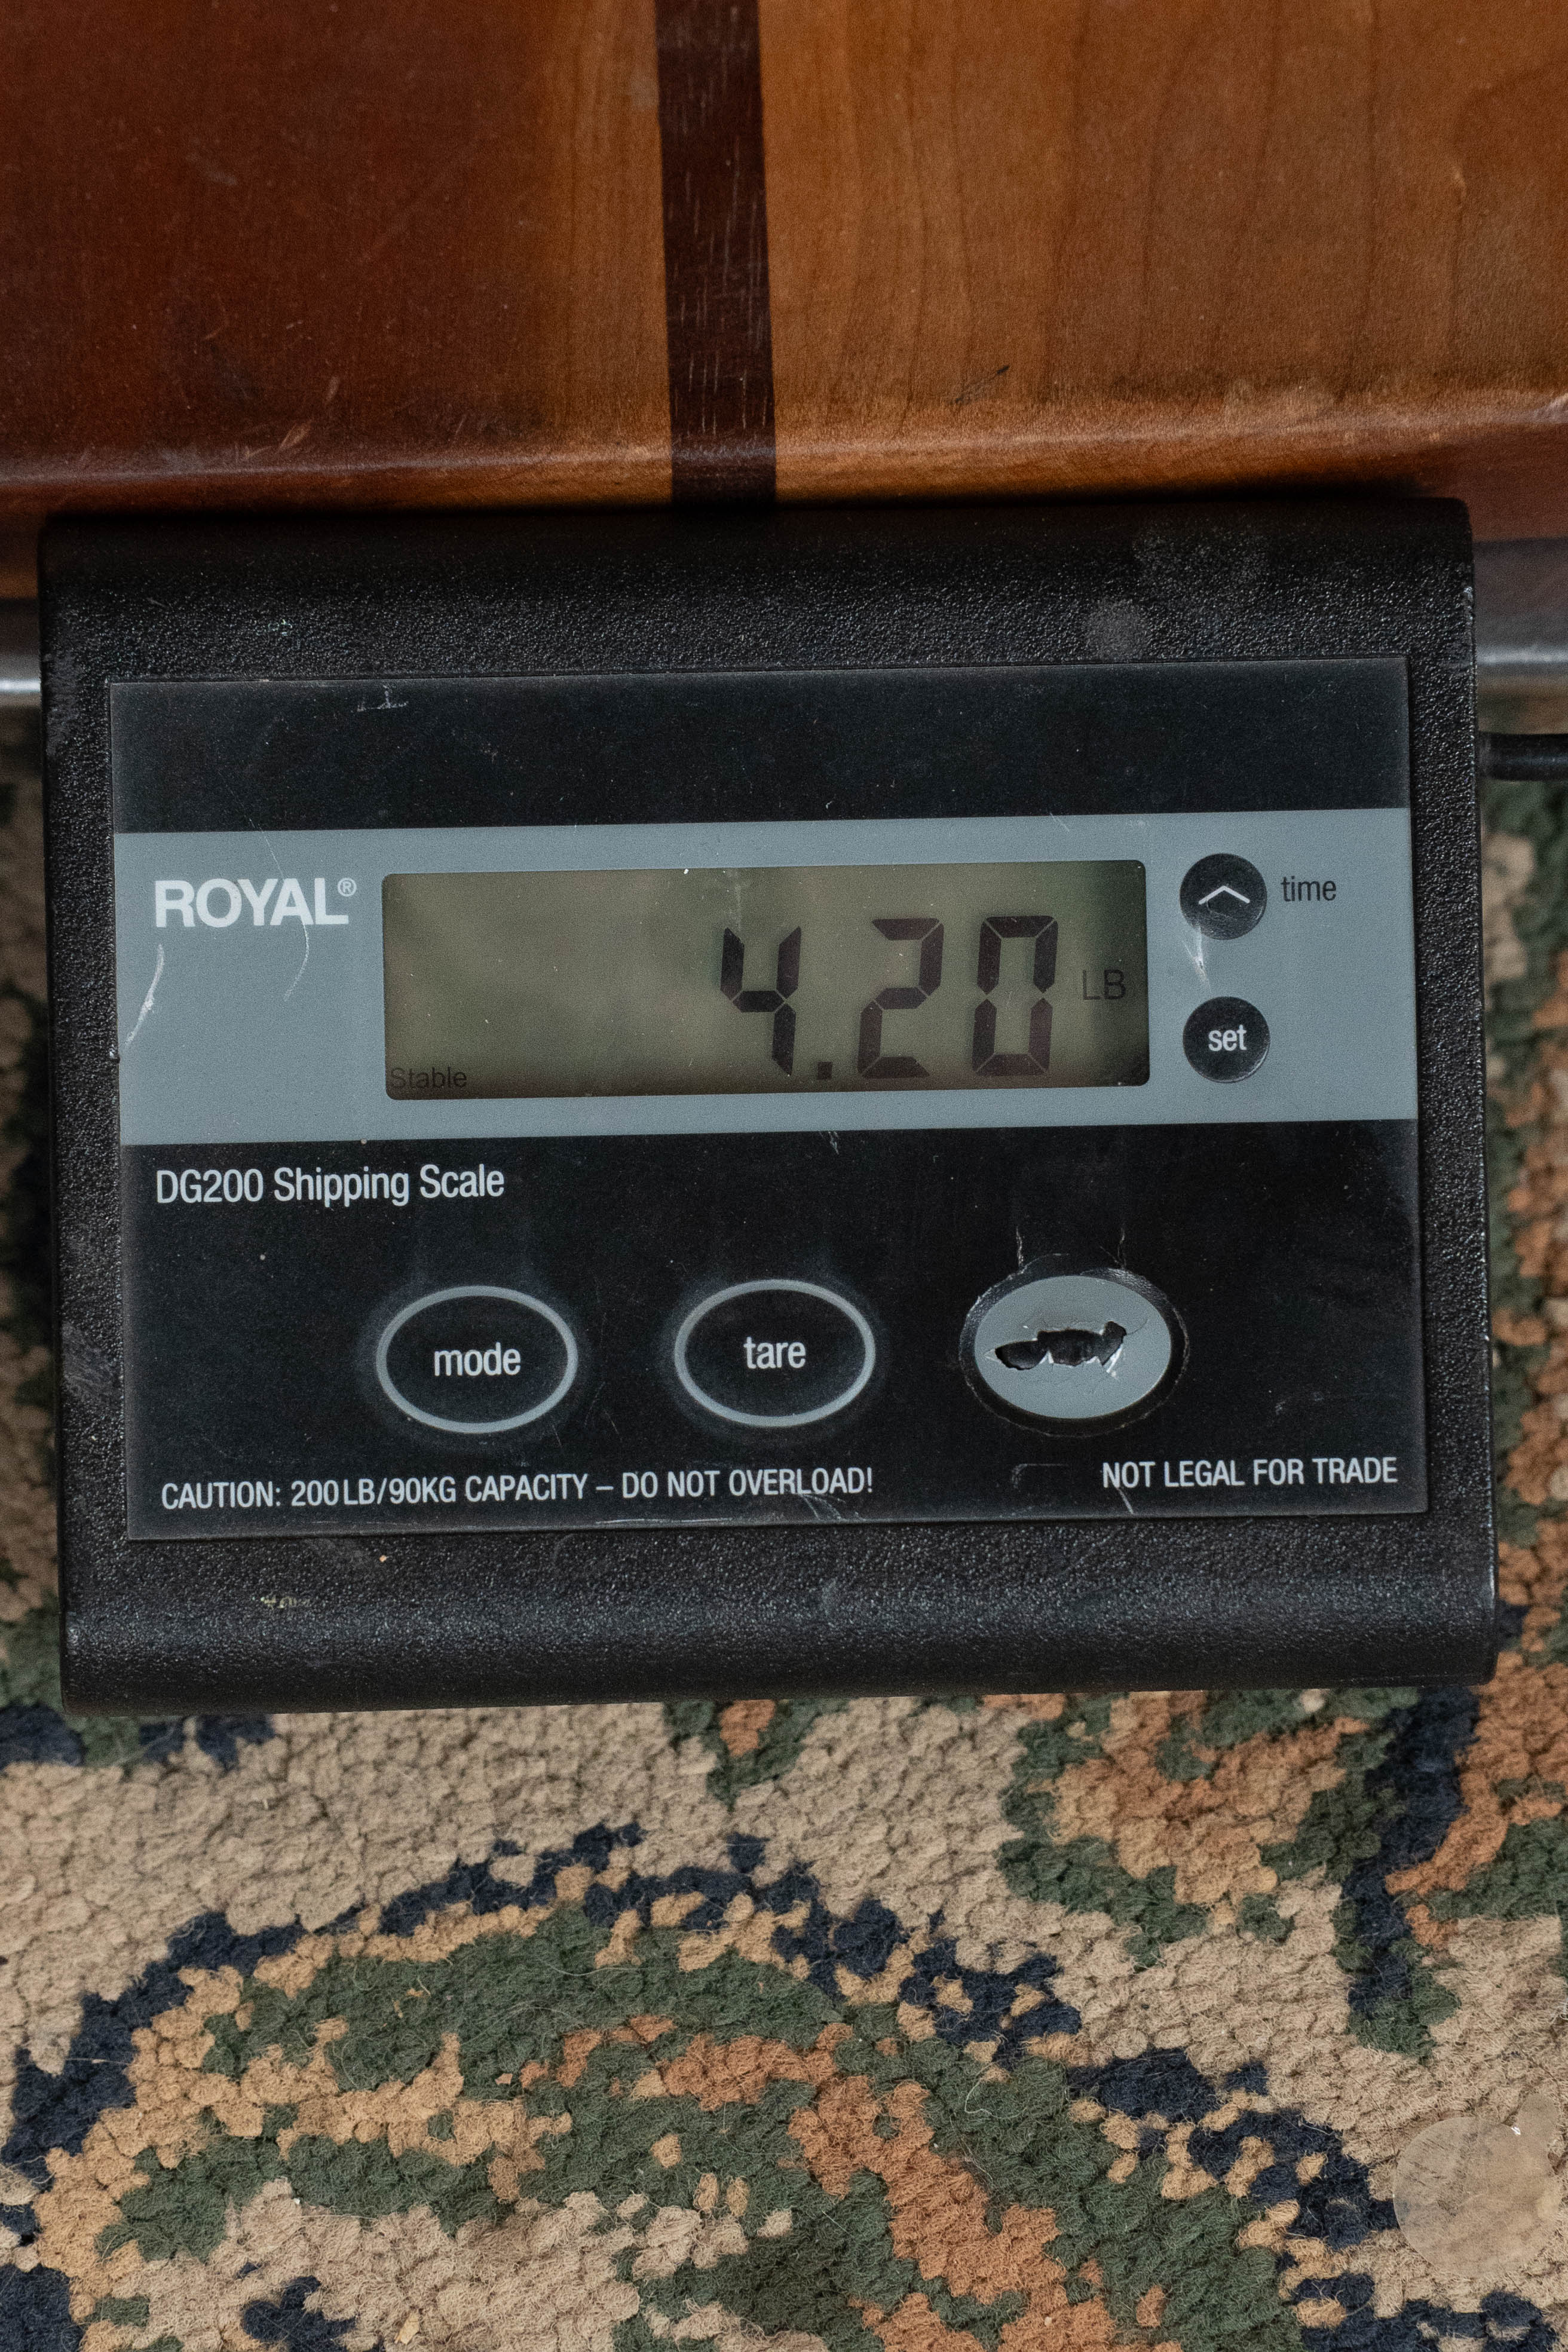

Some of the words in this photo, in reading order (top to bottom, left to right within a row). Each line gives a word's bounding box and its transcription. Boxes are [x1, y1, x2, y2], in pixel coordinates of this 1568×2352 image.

[1281, 875, 1337, 902] time
[720, 915, 1058, 1077] 4.20
[1082, 969, 1126, 1000] LB
[1208, 1024, 1247, 1052] set
[391, 1067, 467, 1090] Stable
[157, 1168, 264, 1203] DG200
[274, 1166, 409, 1207] Shipping
[419, 1163, 504, 1199] Scale
[434, 1342, 520, 1376] mode
[744, 1337, 806, 1368] tare
[162, 1481, 281, 1509] CAUTION:
[465, 1473, 588, 1502] CAPACITY
[622, 1471, 658, 1499] DO
[667, 1470, 719, 1497] NOT
[729, 1467, 873, 1495] OVERLOAD!
[1102, 1461, 1155, 1489] NOT
[1164, 1460, 1244, 1487] LEGAL
[1254, 1458, 1305, 1486] FOR
[1312, 1456, 1398, 1484] TRADE
